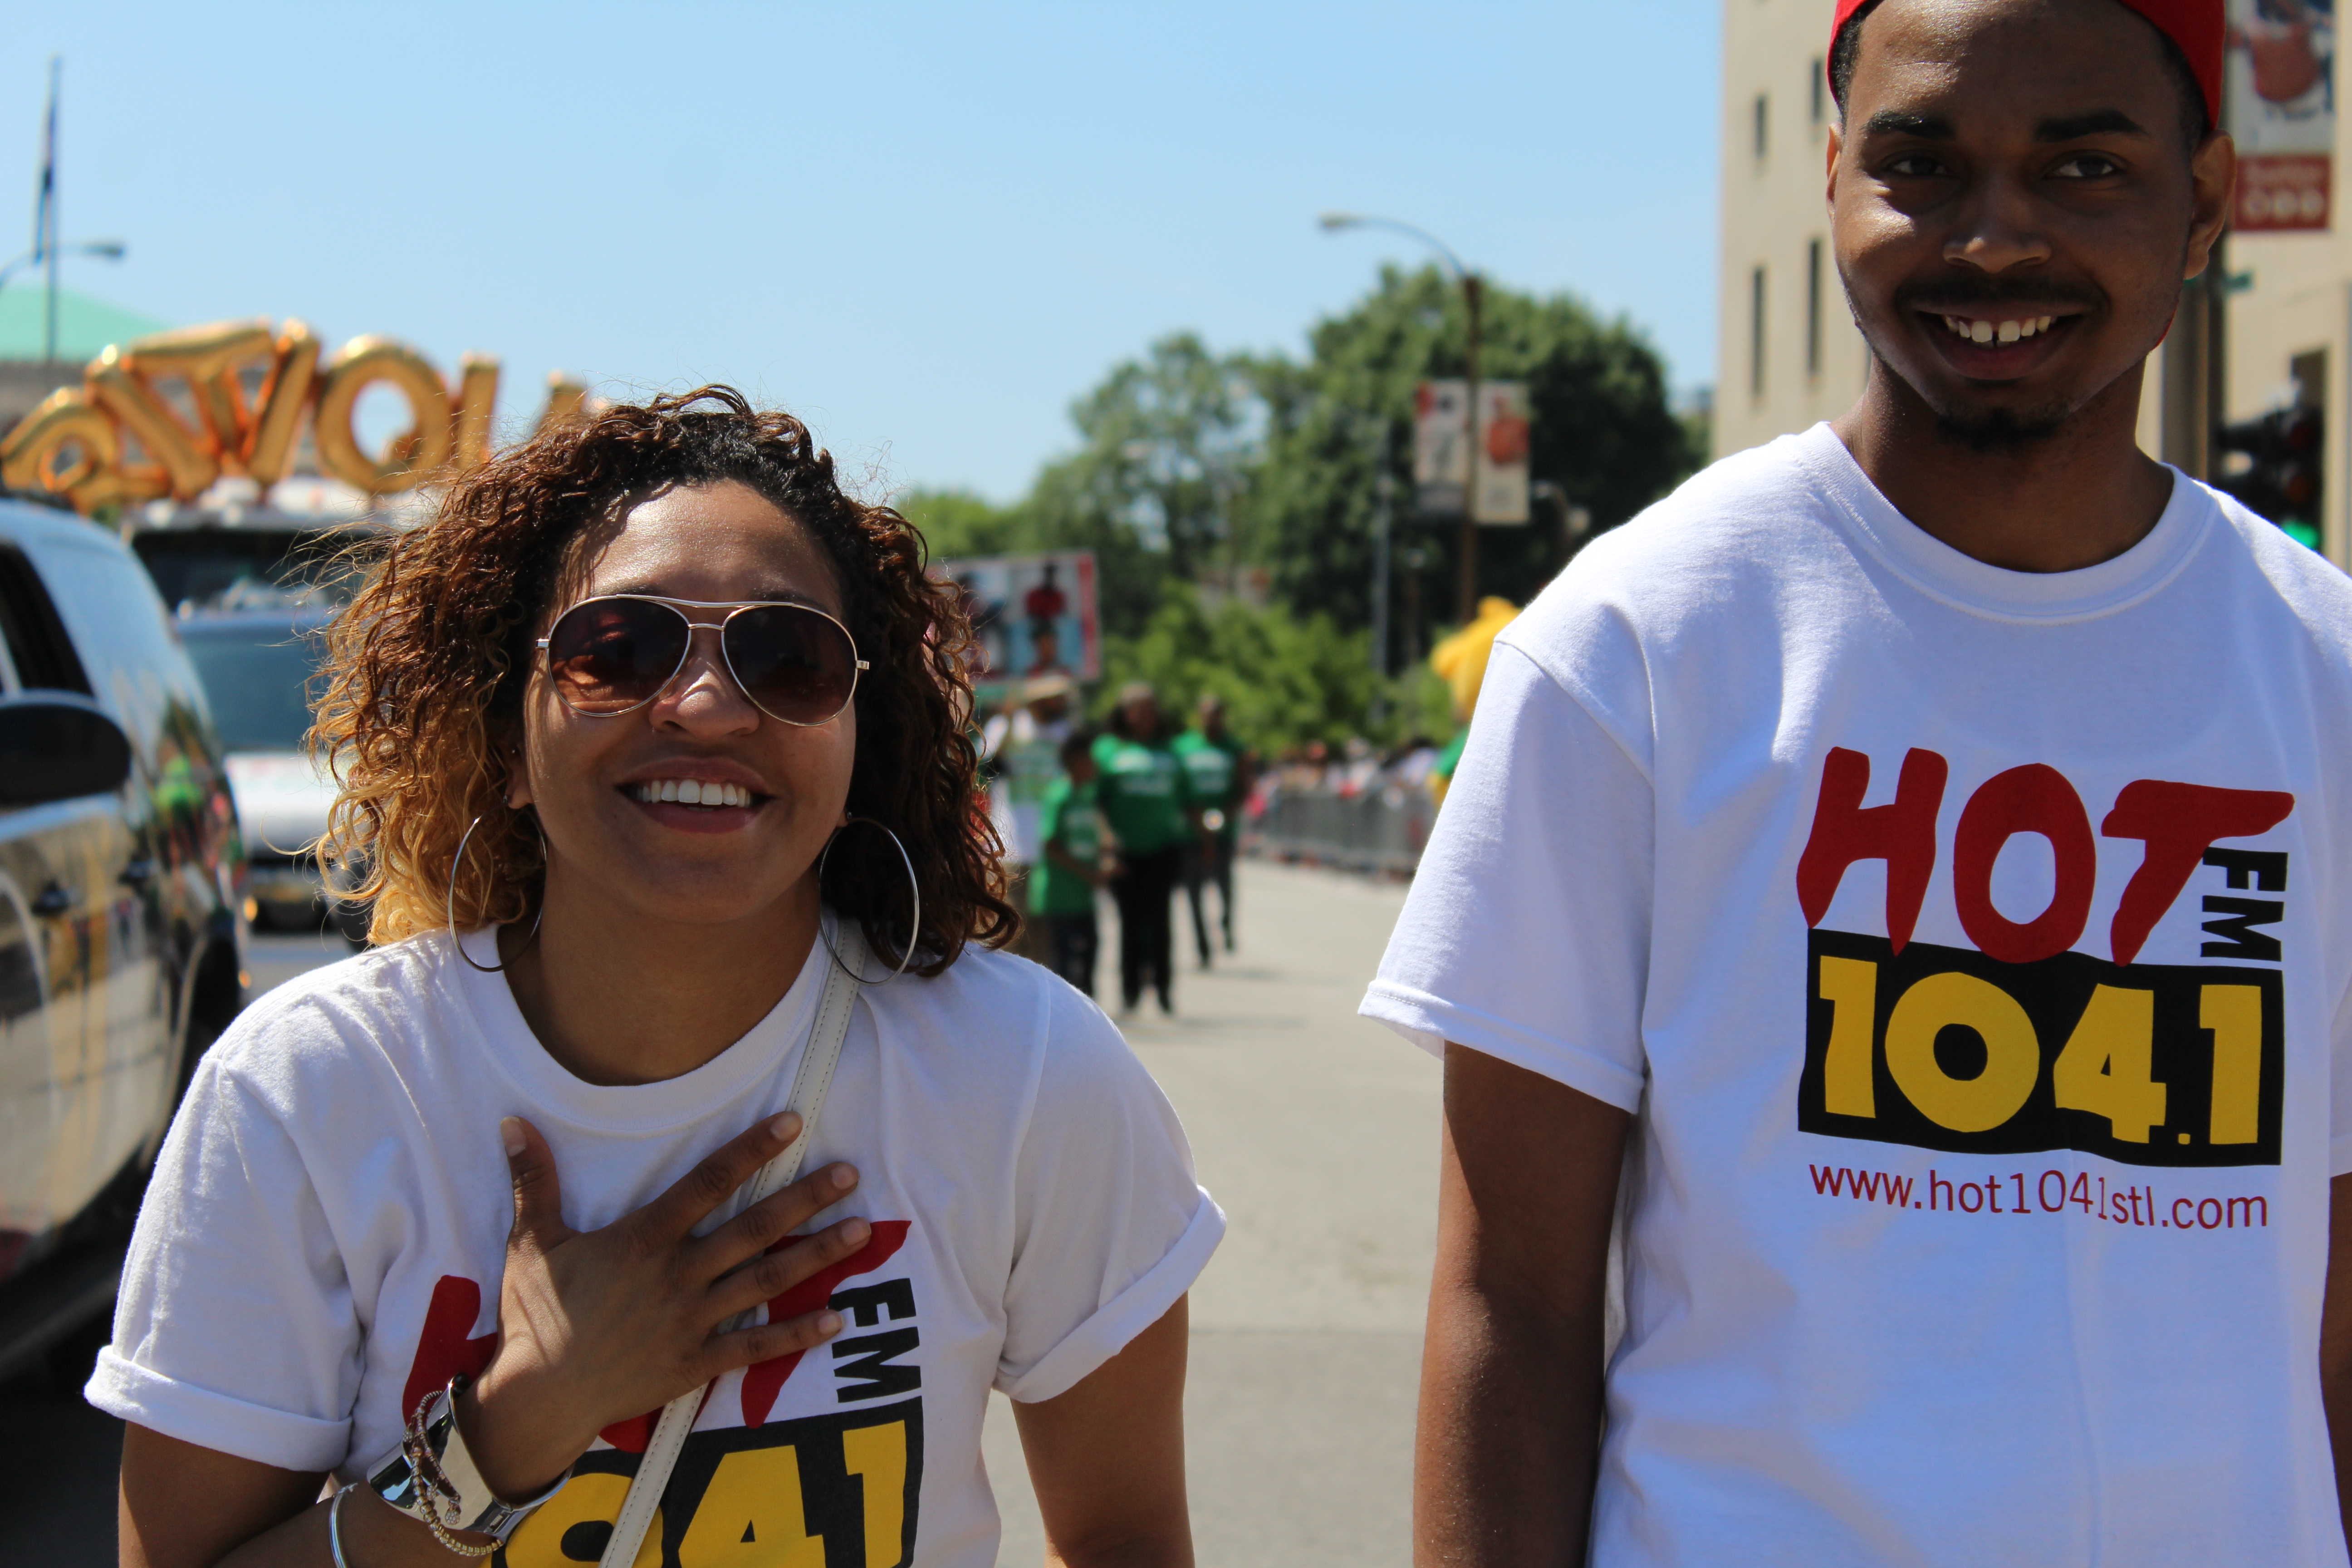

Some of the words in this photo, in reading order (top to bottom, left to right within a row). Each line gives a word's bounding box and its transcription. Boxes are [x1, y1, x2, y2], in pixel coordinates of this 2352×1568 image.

[1795, 746, 2295, 966] HOT
[2200, 847, 2288, 962] FM
[1818, 955, 2263, 1145] 104.1
[1809, 1163, 2269, 1230] www.hot1041stl.com
[829, 1277, 923, 1404] FM
